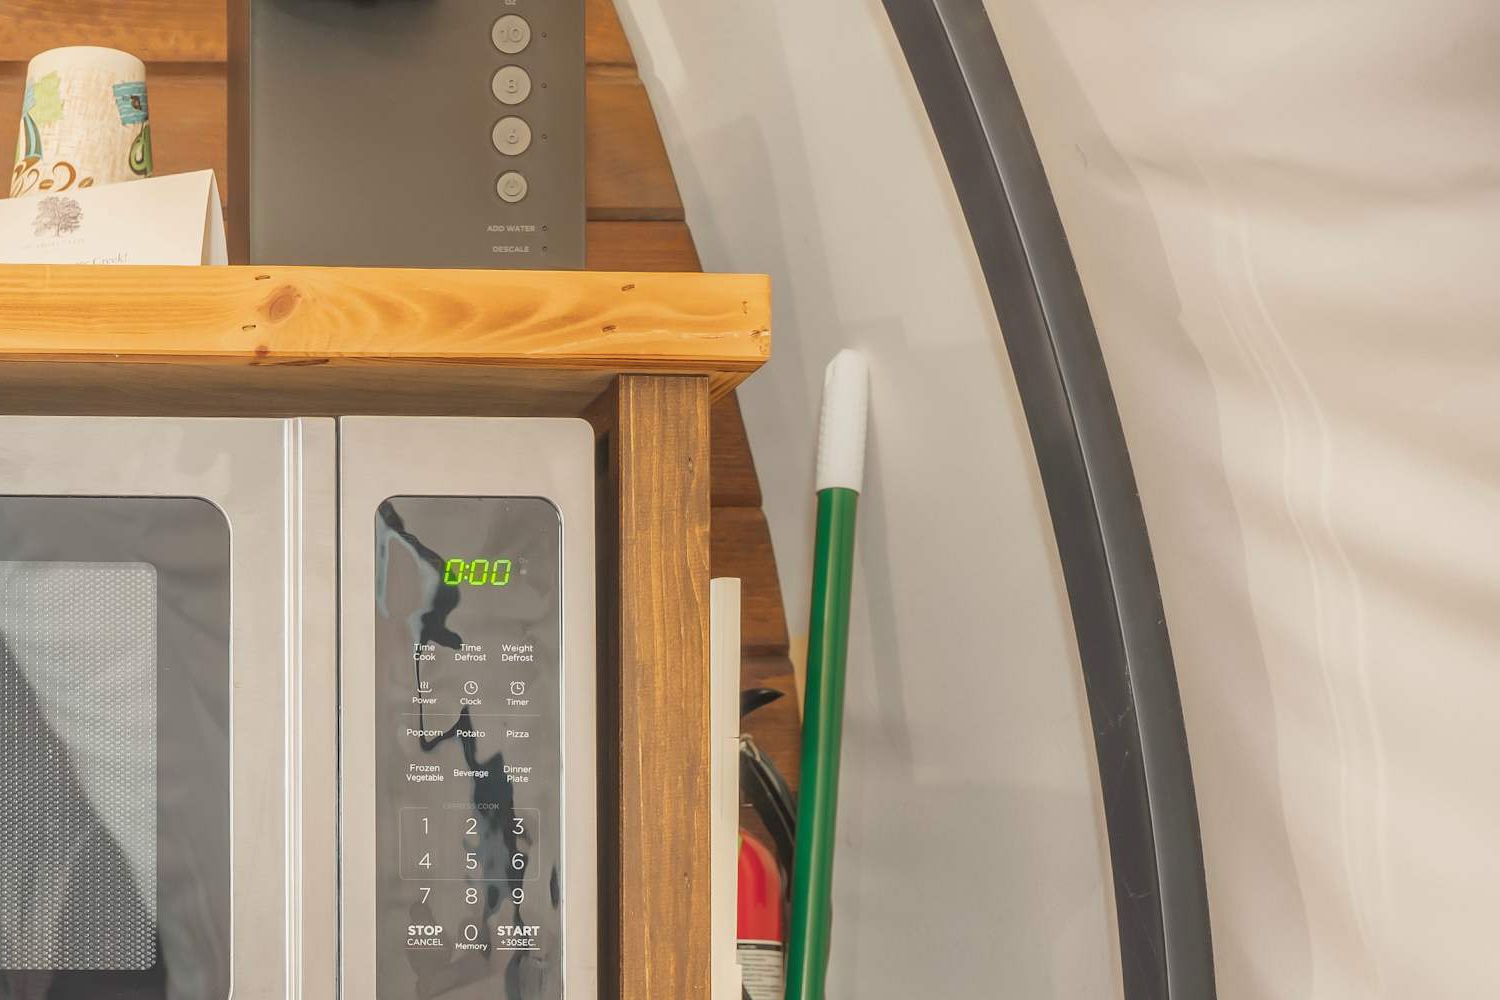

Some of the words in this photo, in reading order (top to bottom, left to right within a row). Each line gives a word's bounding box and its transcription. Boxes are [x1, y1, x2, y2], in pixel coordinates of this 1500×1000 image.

[499, 28, 524, 43] 10
[506, 128, 519, 144] 6
[443, 558, 512, 586] 0:00
[413, 643, 436, 652] Time
[460, 643, 482, 652] Time
[501, 644, 533, 654] Weight
[413, 653, 436, 661] Cook
[454, 653, 487, 661] Defrost
[501, 653, 534, 662] Defrost
[412, 696, 437, 705] Power
[459, 697, 482, 706] Clock
[506, 698, 529, 706] Timer
[406, 728, 444, 739] Popcorn
[456, 729, 486, 738] Potato
[506, 730, 530, 738] Pizza
[409, 763, 440, 772] Frozen
[503, 765, 532, 774] Dinner
[453, 769, 489, 778] Beverage
[406, 774, 444, 783] Vegetable
[506, 775, 529, 783] Plate
[422, 817, 429, 835] 1
[465, 818, 478, 835] 2
[512, 818, 525, 835] 3
[418, 852, 432, 869] 4
[466, 853, 478, 870] 5
[511, 853, 525, 870] 6
[419, 887, 431, 904] 7
[465, 887, 478, 905] 8
[512, 887, 525, 905] 9
[407, 925, 443, 936] STOP
[464, 924, 478, 941] 0
[497, 925, 540, 937] START
[407, 938, 443, 947] CANCEL
[455, 942, 488, 951] Memory
